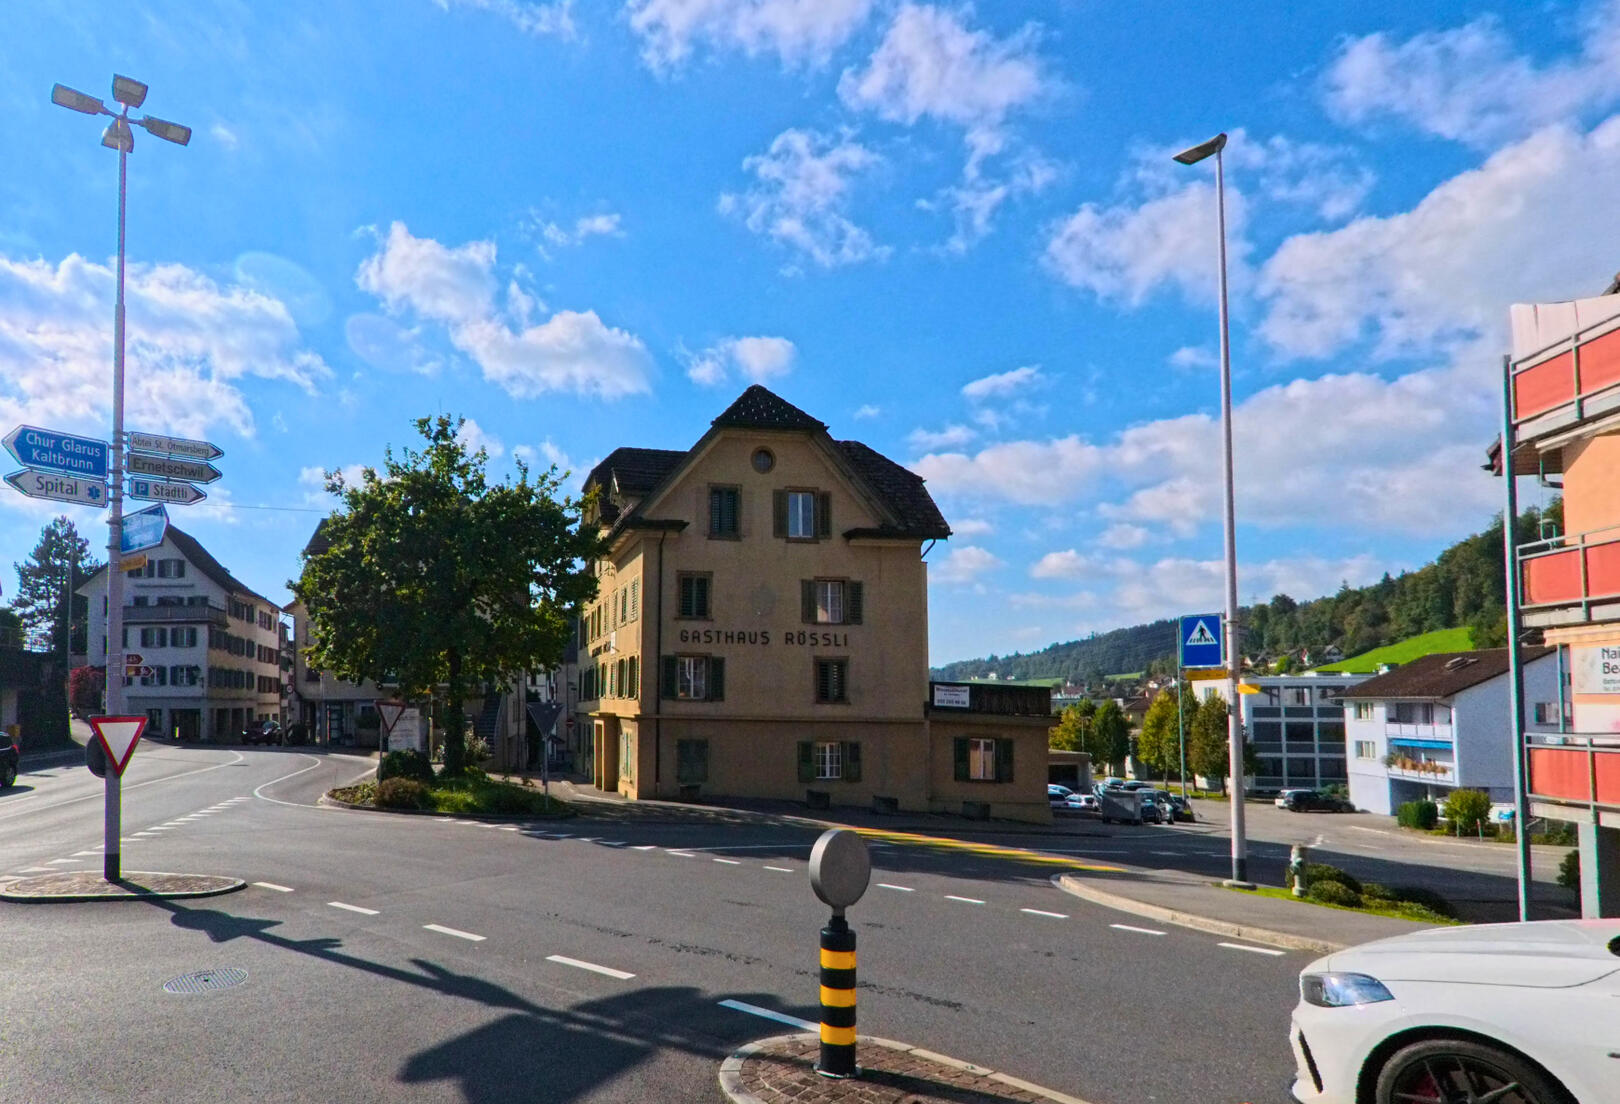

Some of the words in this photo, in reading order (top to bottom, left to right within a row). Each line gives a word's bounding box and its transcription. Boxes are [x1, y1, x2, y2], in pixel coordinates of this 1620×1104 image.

[26, 432, 55, 449] Chur
[62, 439, 101, 457] Glarus
[167, 441, 210, 455] Otmarsberg
[32, 448, 94, 470] Kaltbrunn
[133, 458, 204, 478] Ernetschwil
[36, 476, 78, 495] Spital
[680, 629, 770, 645] GASTHAUS
[785, 630, 848, 647] RÖSSLI
[1602, 662, 1620, 675] Be
